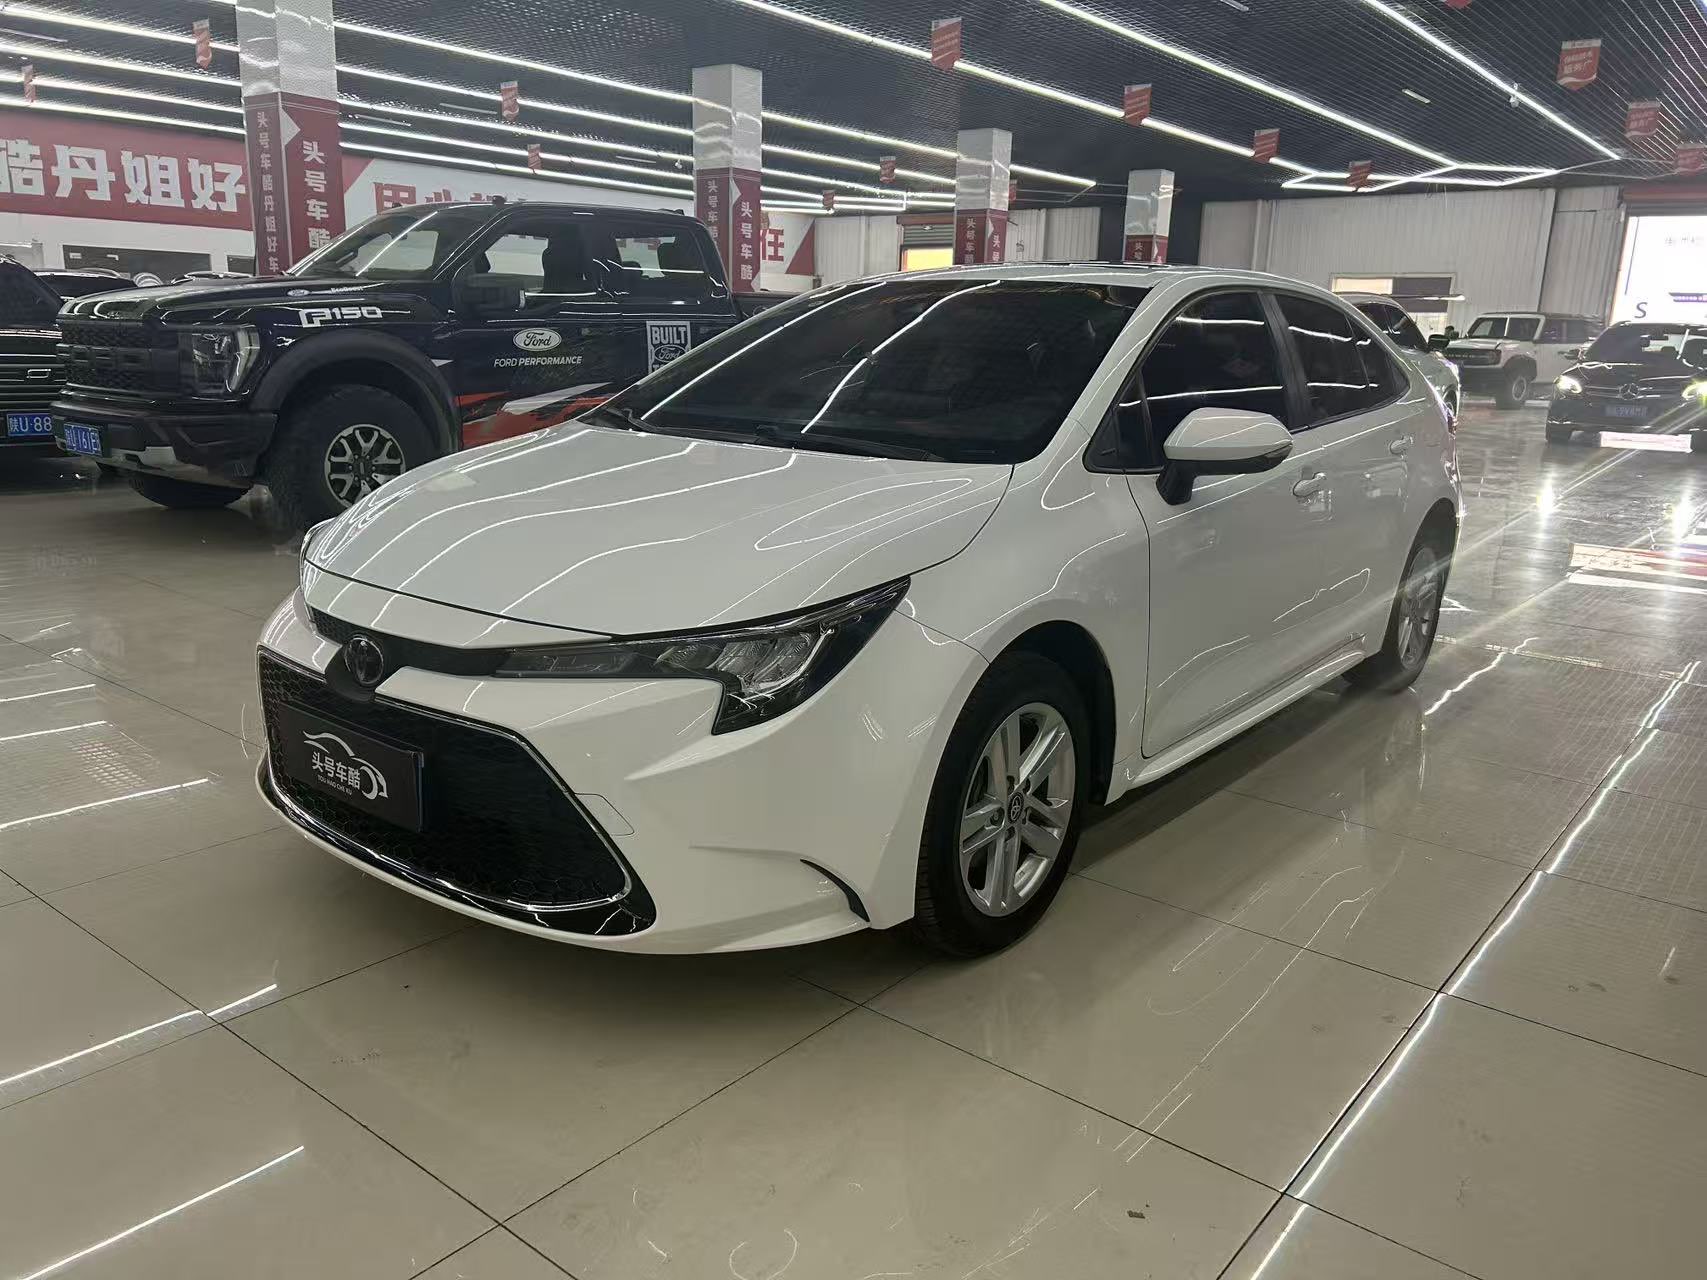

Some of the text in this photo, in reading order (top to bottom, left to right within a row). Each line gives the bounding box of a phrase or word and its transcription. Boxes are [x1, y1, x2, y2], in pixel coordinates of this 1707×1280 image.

[302, 140, 331, 249] 头号车酷
[523, 332, 552, 347] Ford
[651, 326, 687, 344] BUILT
[658, 346, 682, 360] Ford
[494, 355, 583, 368] FORD PERFORMANCE
[312, 751, 361, 790] 头号车酷
